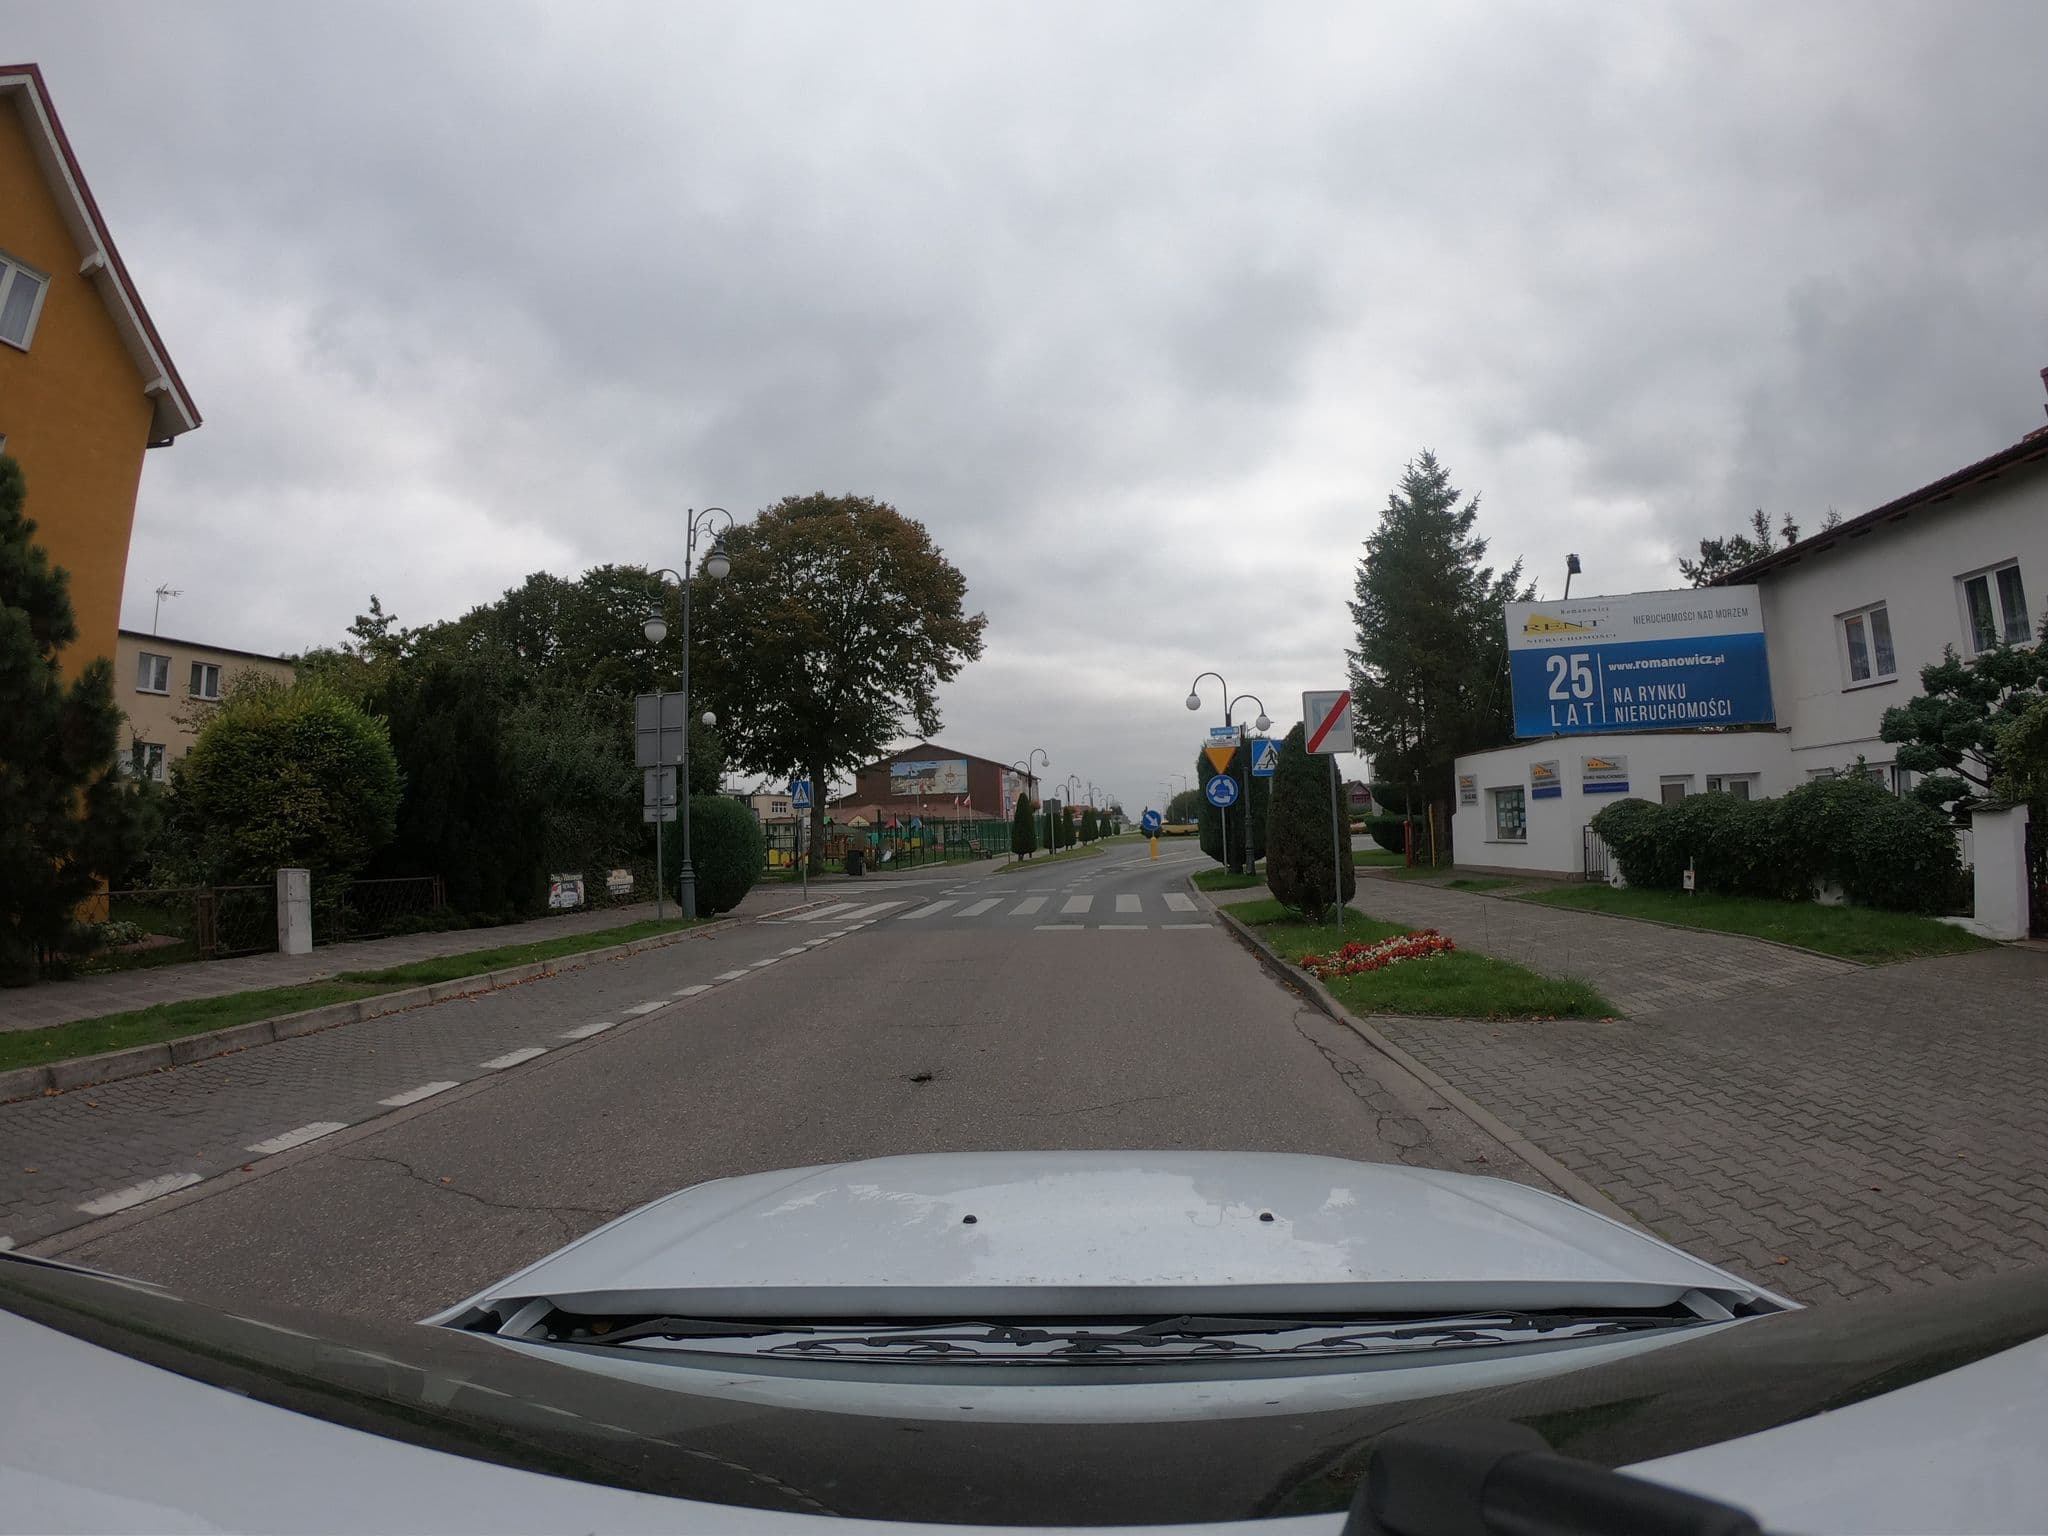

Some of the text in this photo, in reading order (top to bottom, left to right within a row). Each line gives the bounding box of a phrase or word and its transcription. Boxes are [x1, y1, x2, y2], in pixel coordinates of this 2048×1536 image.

[1560, 607, 1609, 615] Romanowicz
[1633, 607, 1749, 625] NIERUCHOMOŚCI NAD MORZEM
[1523, 618, 1606, 632] RENT
[1608, 653, 1725, 671] www.romanowicz.pl
[1546, 653, 1594, 700] 25
[1613, 683, 1687, 703] NA RYNKU
[1551, 702, 1594, 727] LAT
[1614, 698, 1732, 723] NIERUCHOMOŚCI
